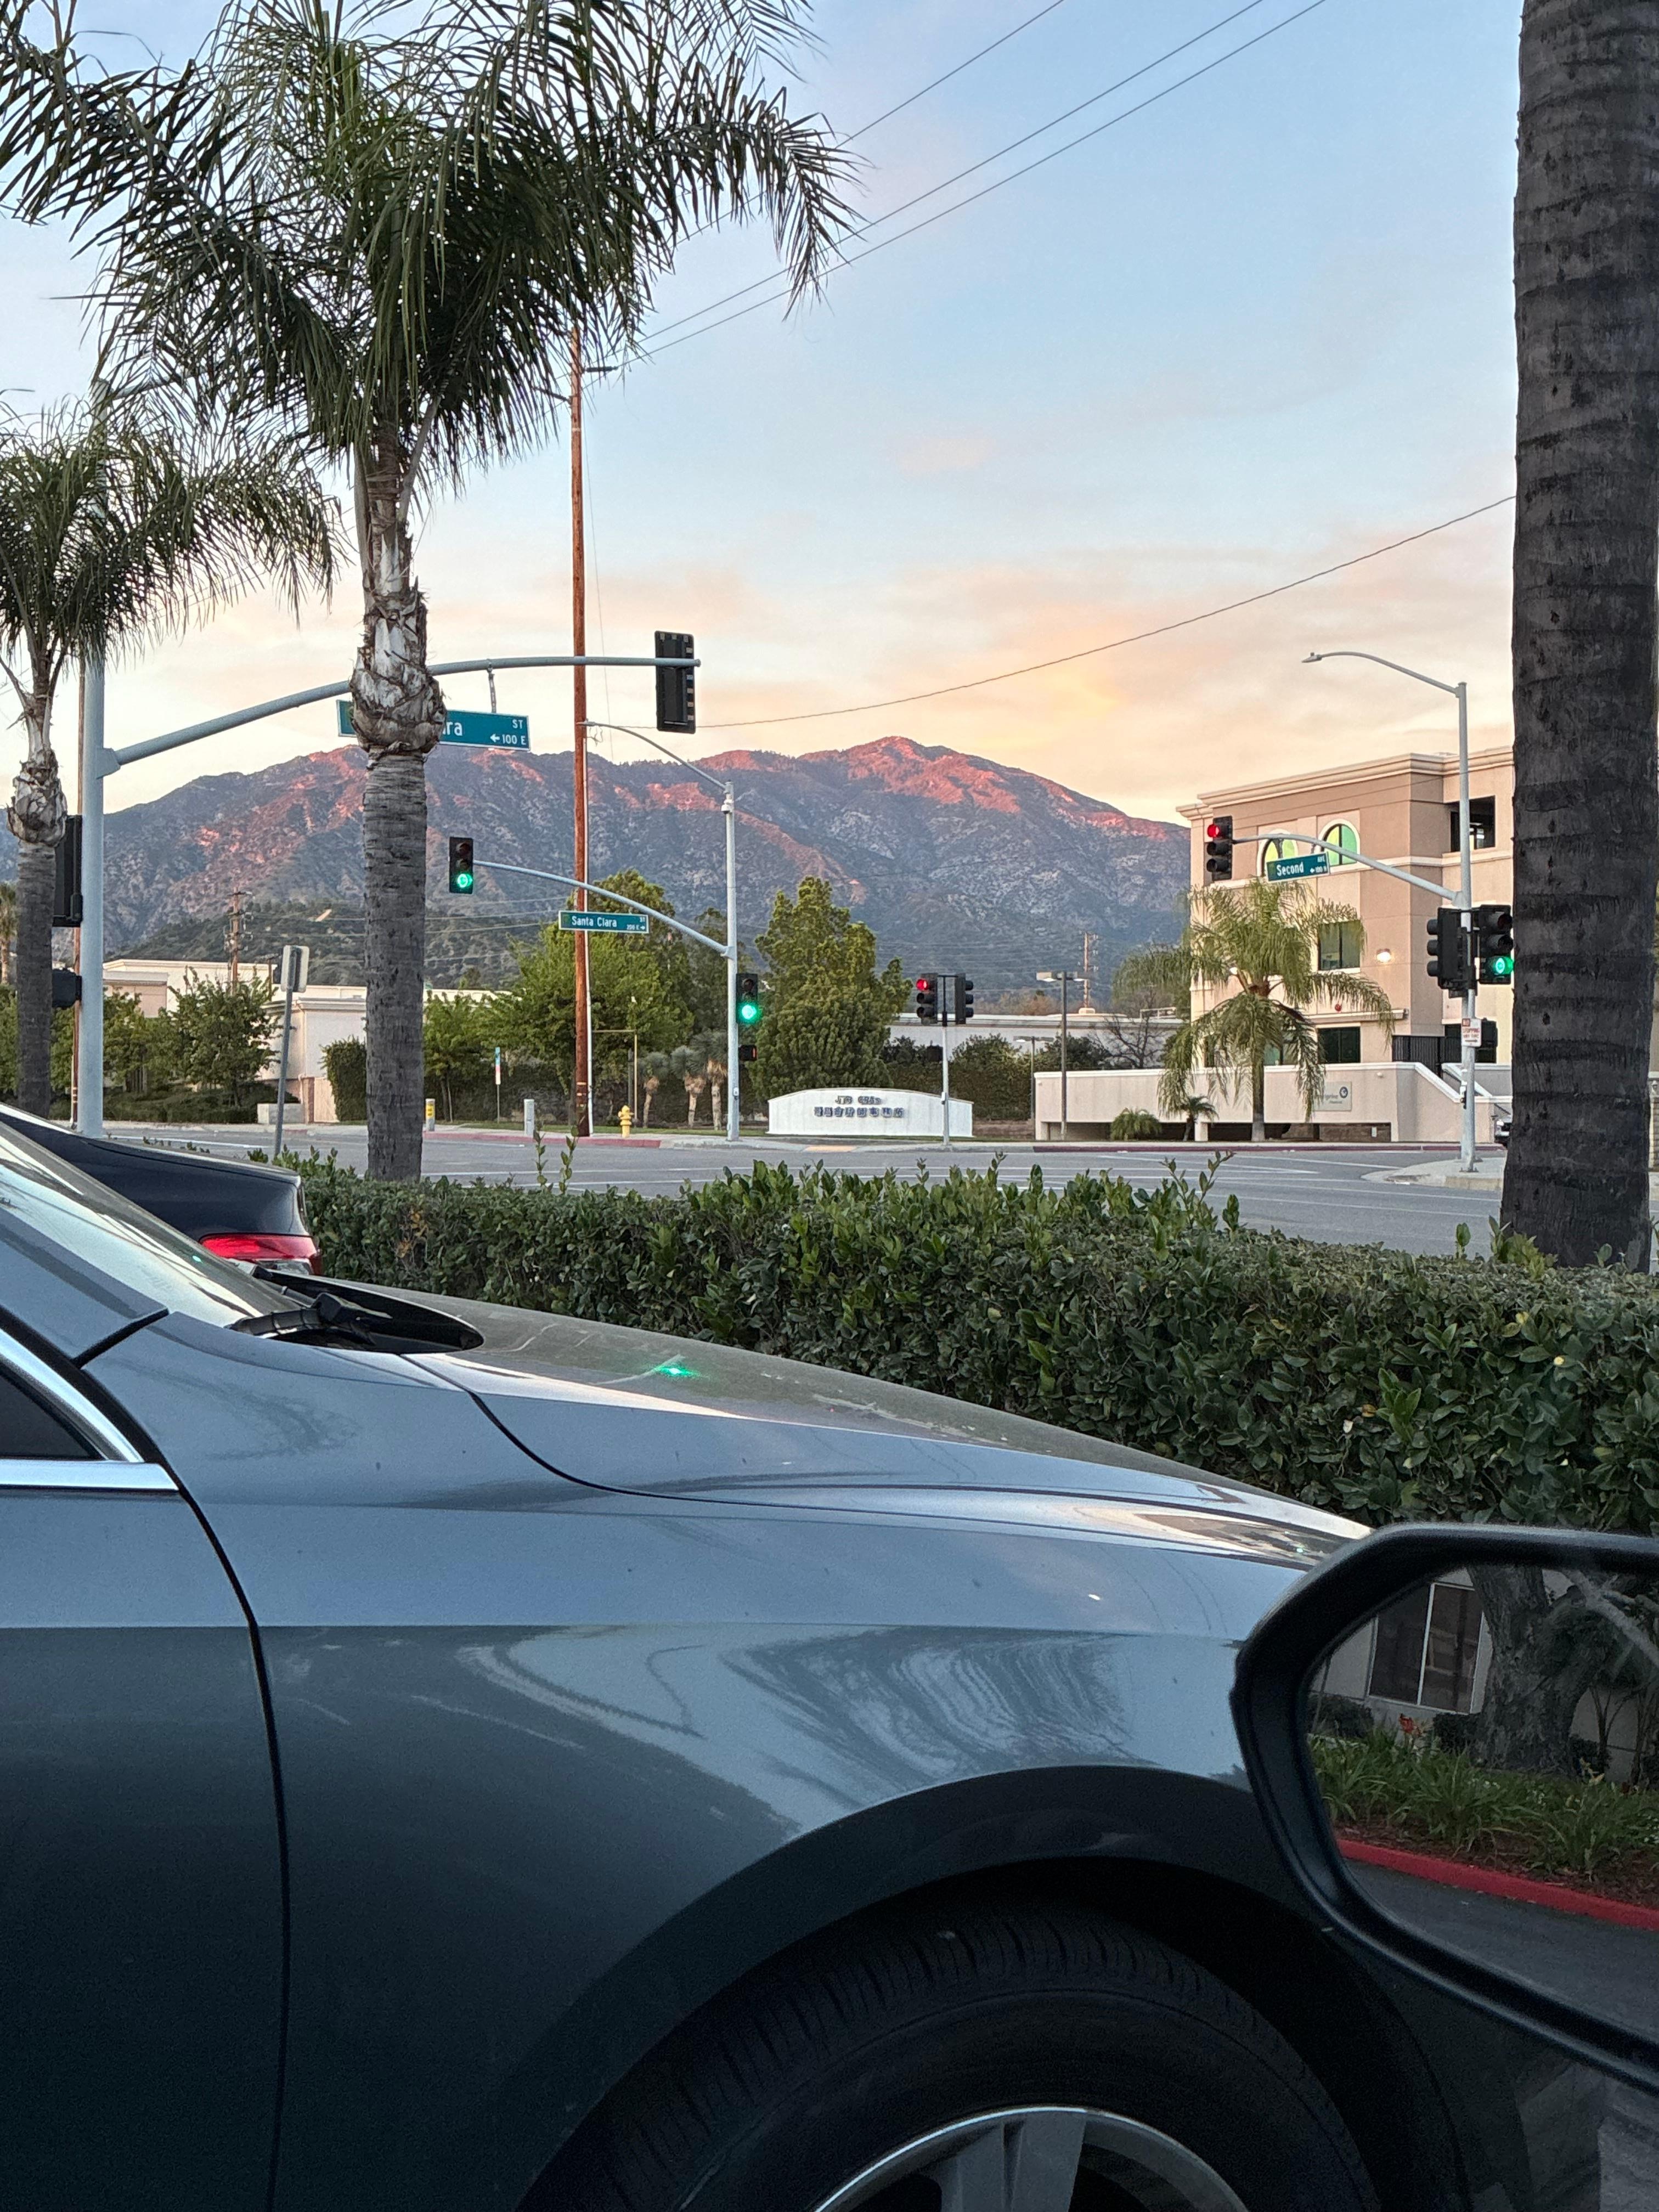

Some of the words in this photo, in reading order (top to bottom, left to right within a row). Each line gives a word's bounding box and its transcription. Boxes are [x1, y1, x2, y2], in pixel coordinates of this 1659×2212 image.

[512, 719, 523, 729] ST
[502, 734, 517, 744] 100
[521, 736, 526, 745] E
[1276, 861, 1304, 876] Second
[572, 916, 594, 927] Santa
[597, 917, 617, 928] Clara
